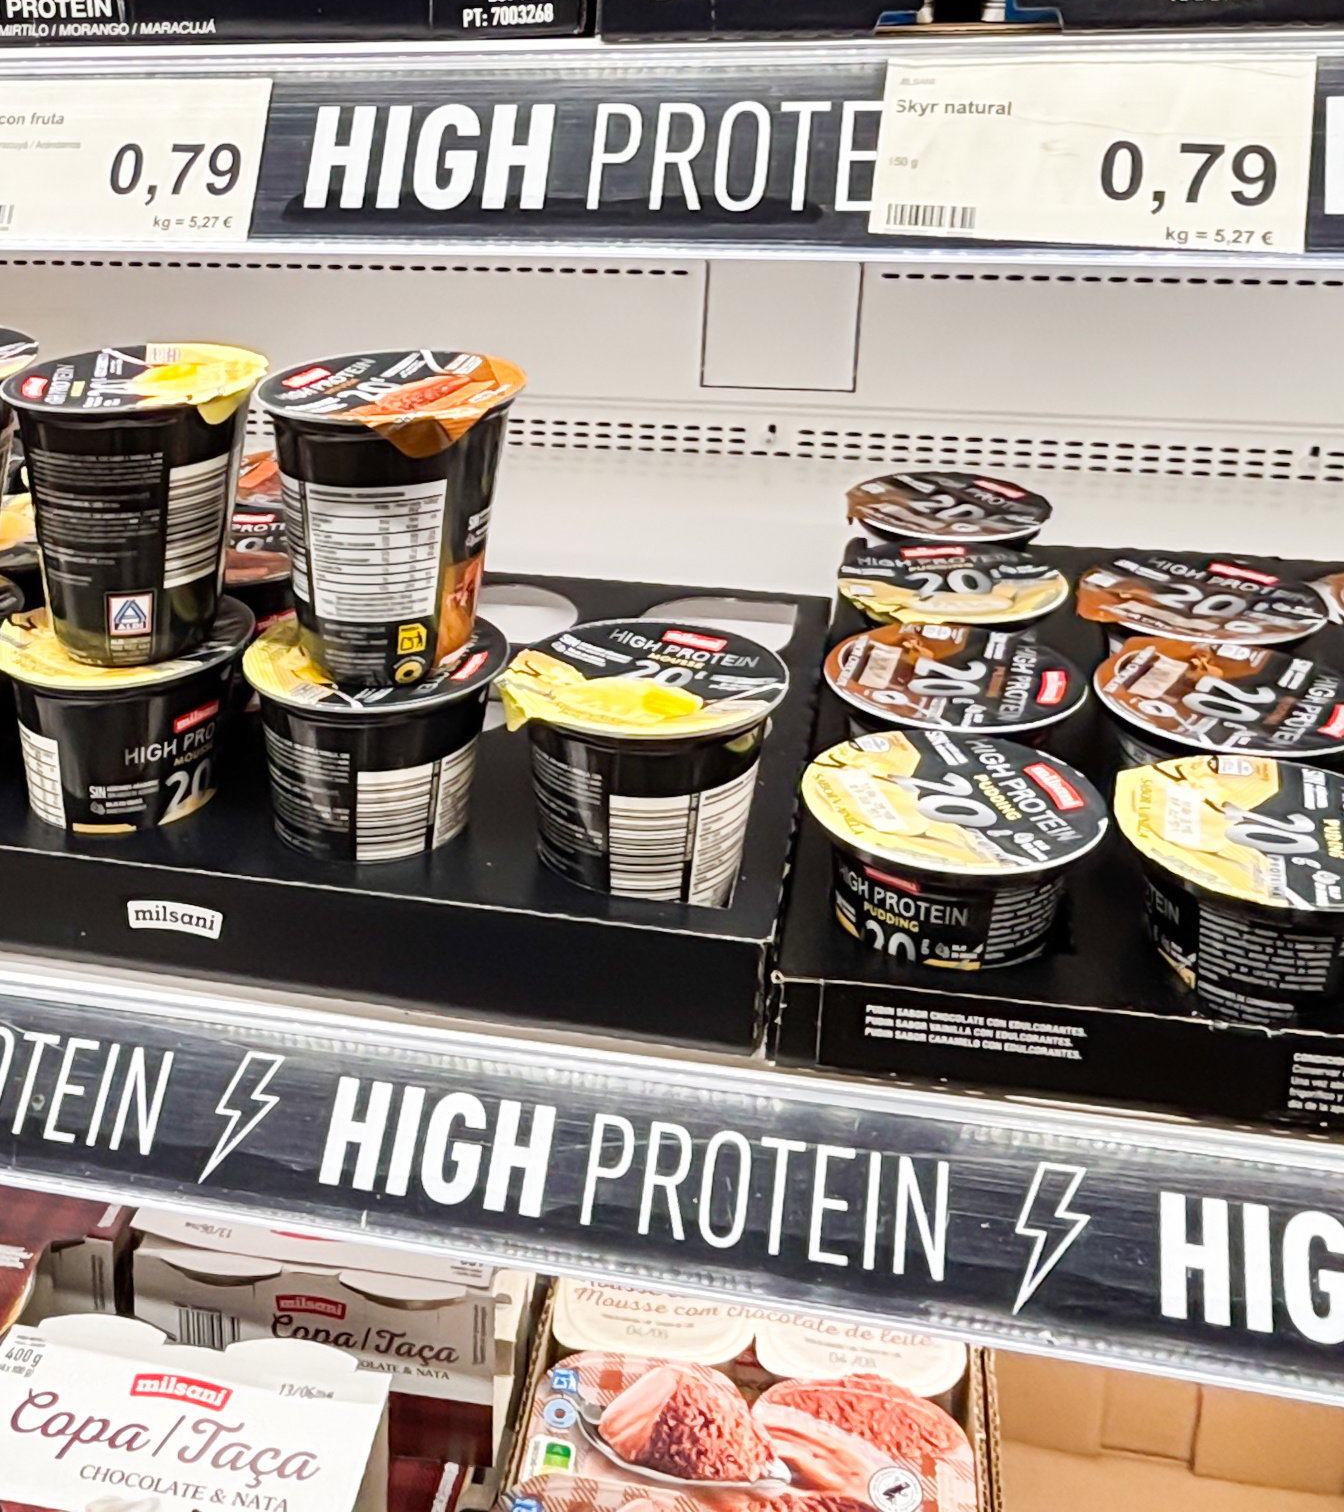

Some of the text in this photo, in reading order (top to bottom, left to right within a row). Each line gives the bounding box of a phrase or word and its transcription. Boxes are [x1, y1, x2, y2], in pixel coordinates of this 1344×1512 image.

[60, 23, 129, 37] MORANGO
[139, 19, 216, 36] MARACUJÁ
[491, 3, 555, 27] 7003268
[30, 111, 65, 126] fruta
[895, 99, 1012, 118] Skyr natural
[109, 143, 242, 206] 0,79
[303, 99, 884, 215] HIGH PROTE
[1101, 140, 1277, 215] 0,79
[188, 215, 220, 229] 5,27
[1165, 226, 1255, 245] kg 5,27
[660, 640, 760, 670] PROTEIN
[125, 738, 178, 766] HIGH
[974, 774, 1022, 822] PUDDING
[999, 775, 1083, 842] PROTEIN
[133, 904, 216, 932] milsani
[864, 900, 920, 933] PUDDING
[873, 886, 969, 927] PROTEIN
[320, 1081, 560, 1218] HIGH
[579, 1112, 952, 1282] PROTEIN
[674, 1303, 720, 1321] com
[845, 1320, 872, 1340] de
[374, 1328, 459, 1369] Taça
[136, 1375, 229, 1408] milsani
[10, 1388, 320, 1488] Copa Taça
[79, 1462, 207, 1502] CHOCOLATE
